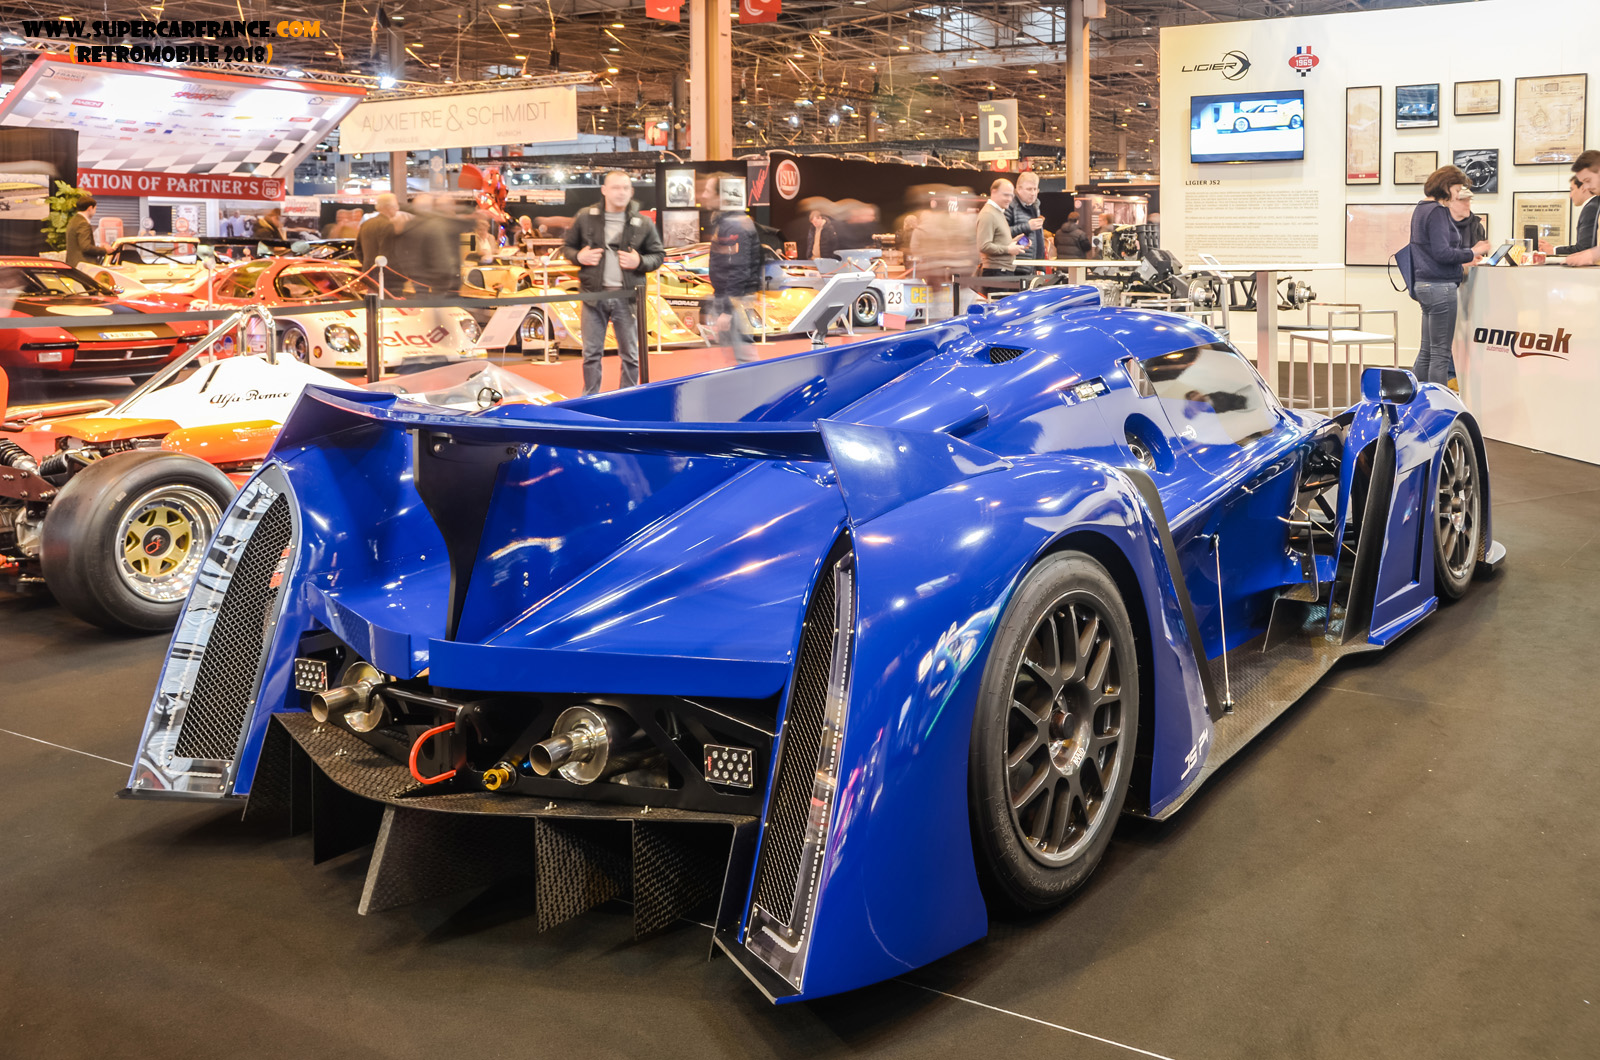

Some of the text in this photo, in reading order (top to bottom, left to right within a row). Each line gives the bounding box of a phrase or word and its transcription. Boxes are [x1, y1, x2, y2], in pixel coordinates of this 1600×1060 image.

[1181, 62, 1237, 73] LIGIER
[361, 101, 551, 132] AUXIETRE & SCHMIDT
[988, 114, 1009, 145] R
[77, 174, 260, 195] ATION OF PARTNER'S
[887, 291, 903, 305] 23
[1473, 328, 1572, 358] onroak
[210, 389, 291, 408] Alfa Romeo
